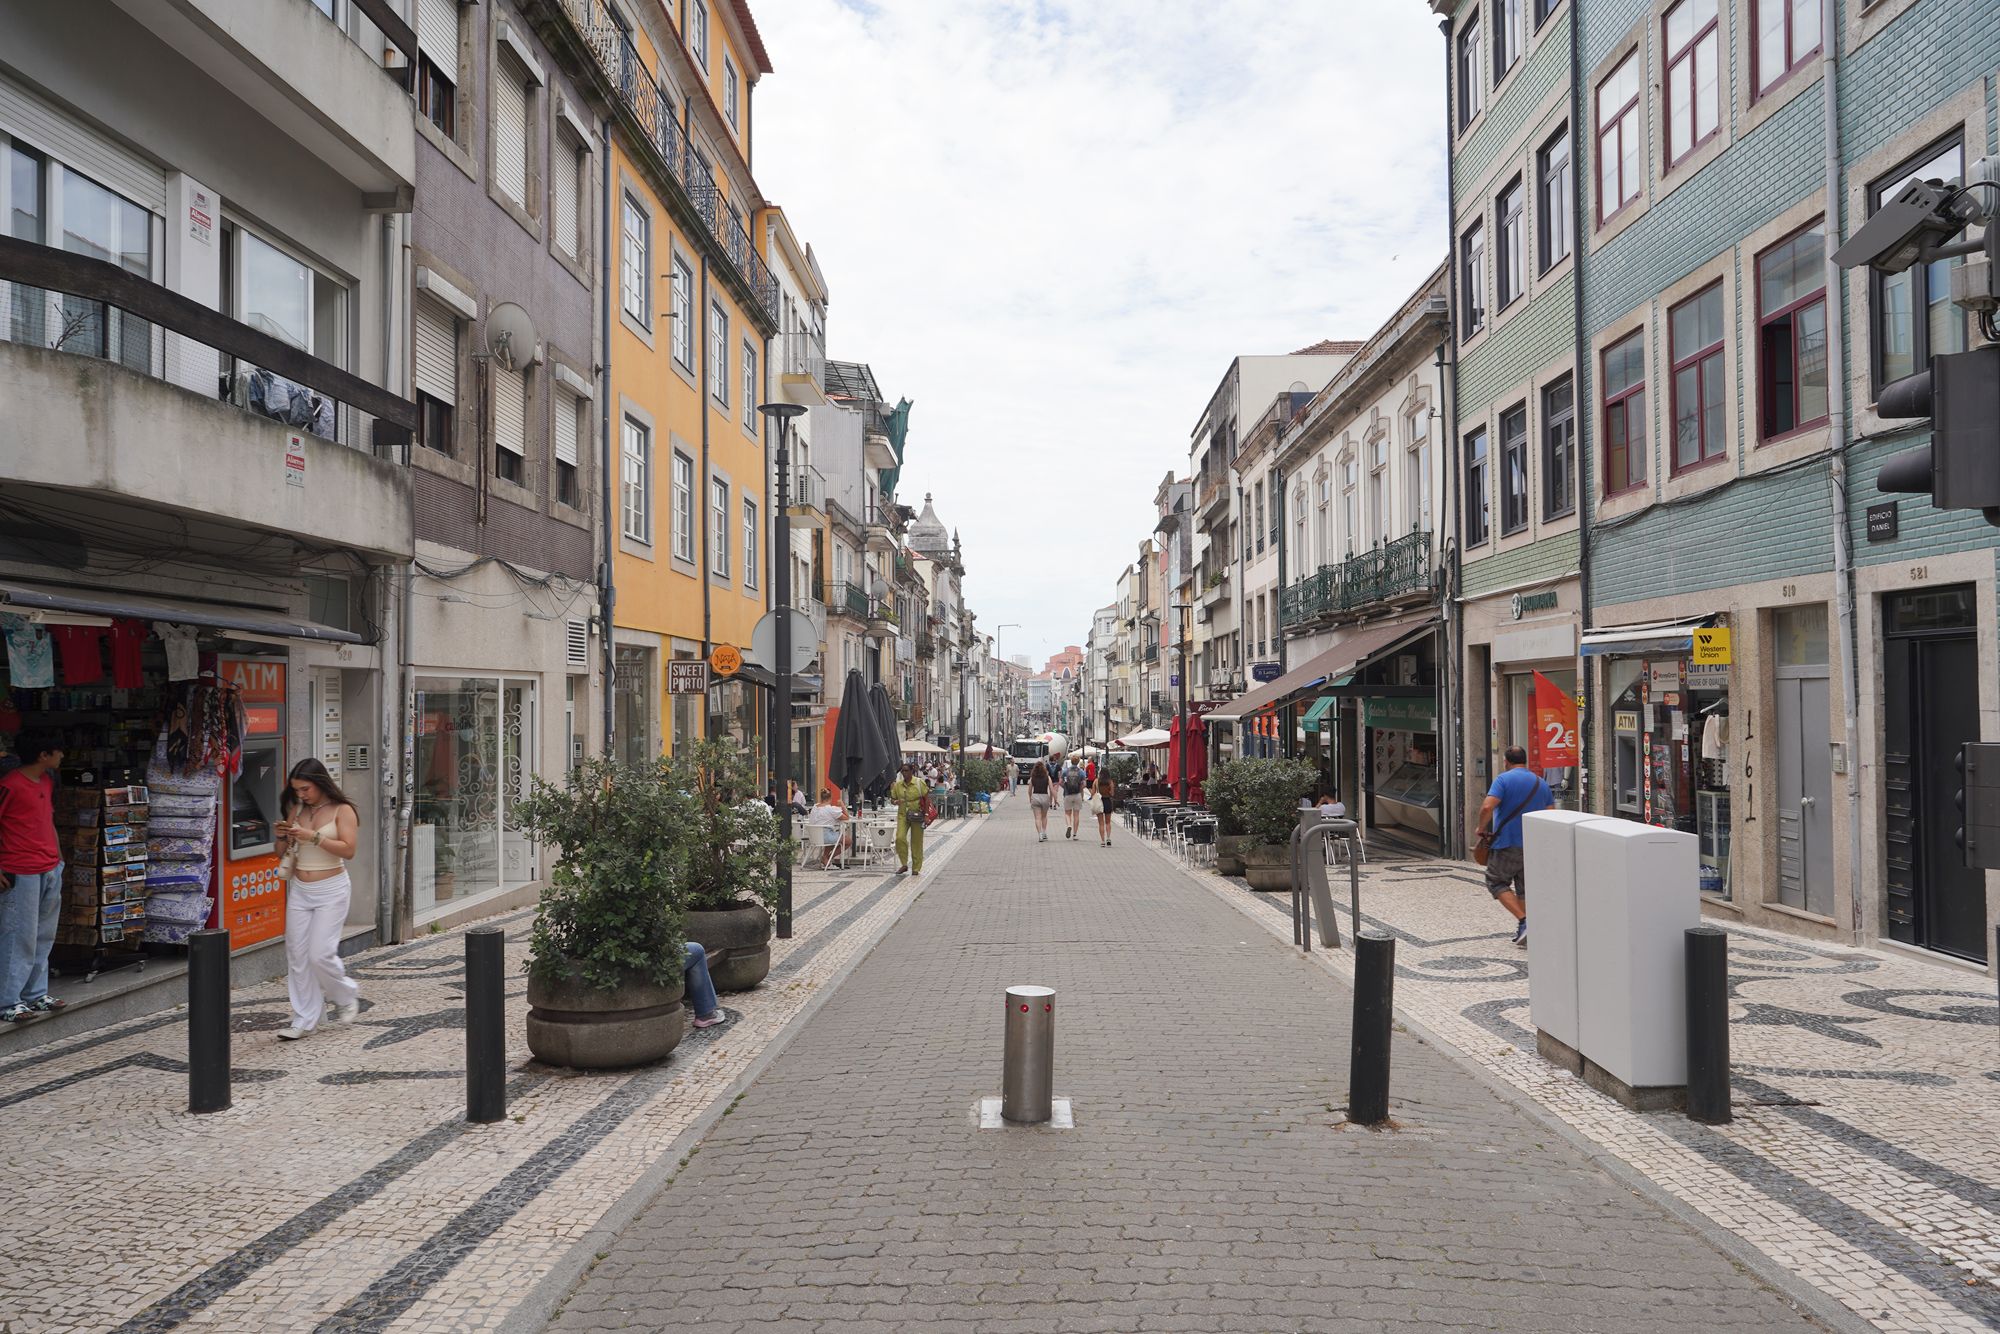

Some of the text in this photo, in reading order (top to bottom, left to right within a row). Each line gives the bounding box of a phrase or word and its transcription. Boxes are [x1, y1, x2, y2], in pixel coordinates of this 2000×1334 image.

[191, 208, 211, 227] Alarme
[287, 455, 305, 467] Alarme
[1871, 522, 1890, 532] DANIEL
[1910, 566, 1928, 580] 521
[1782, 585, 1796, 598] 519
[1523, 591, 1558, 612] HUMANA
[232, 663, 278, 690] ATM
[672, 664, 703, 676] SWEET
[672, 677, 703, 691] PORTO
[1618, 715, 1636, 729] ATM
[1545, 722, 1576, 749] 2€
